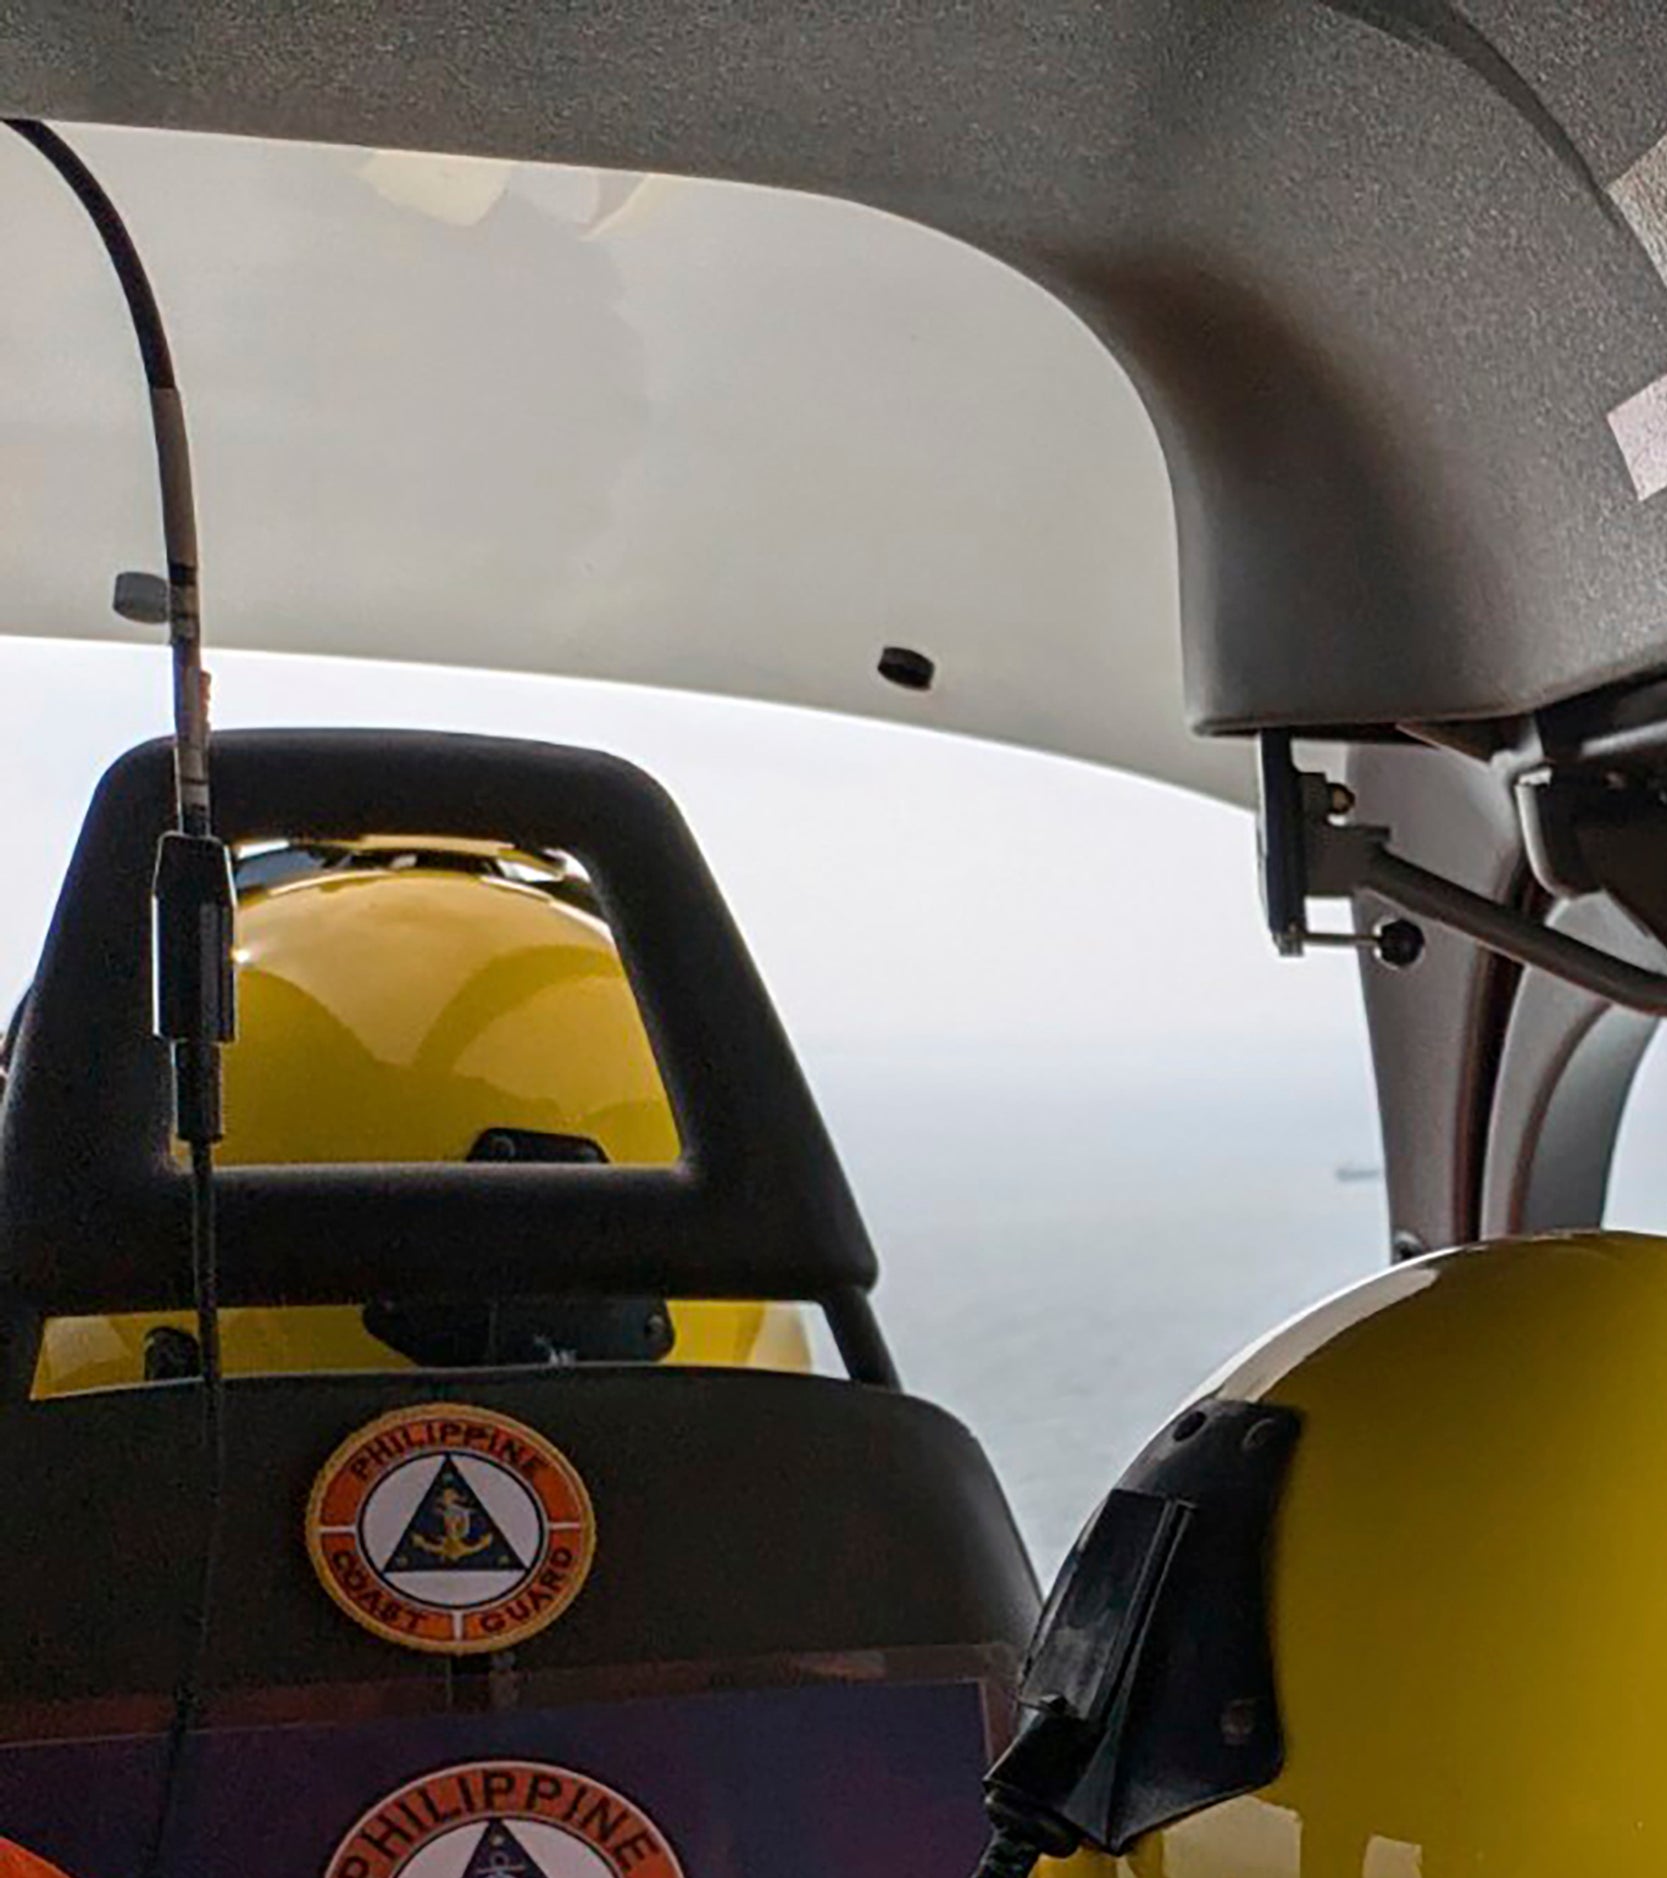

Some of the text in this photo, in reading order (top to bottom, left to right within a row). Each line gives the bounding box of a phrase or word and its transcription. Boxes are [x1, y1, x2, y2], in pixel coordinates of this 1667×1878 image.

[353, 1421, 548, 1481] PHILIPPINE
[334, 1548, 573, 1633] COAST GUARD
